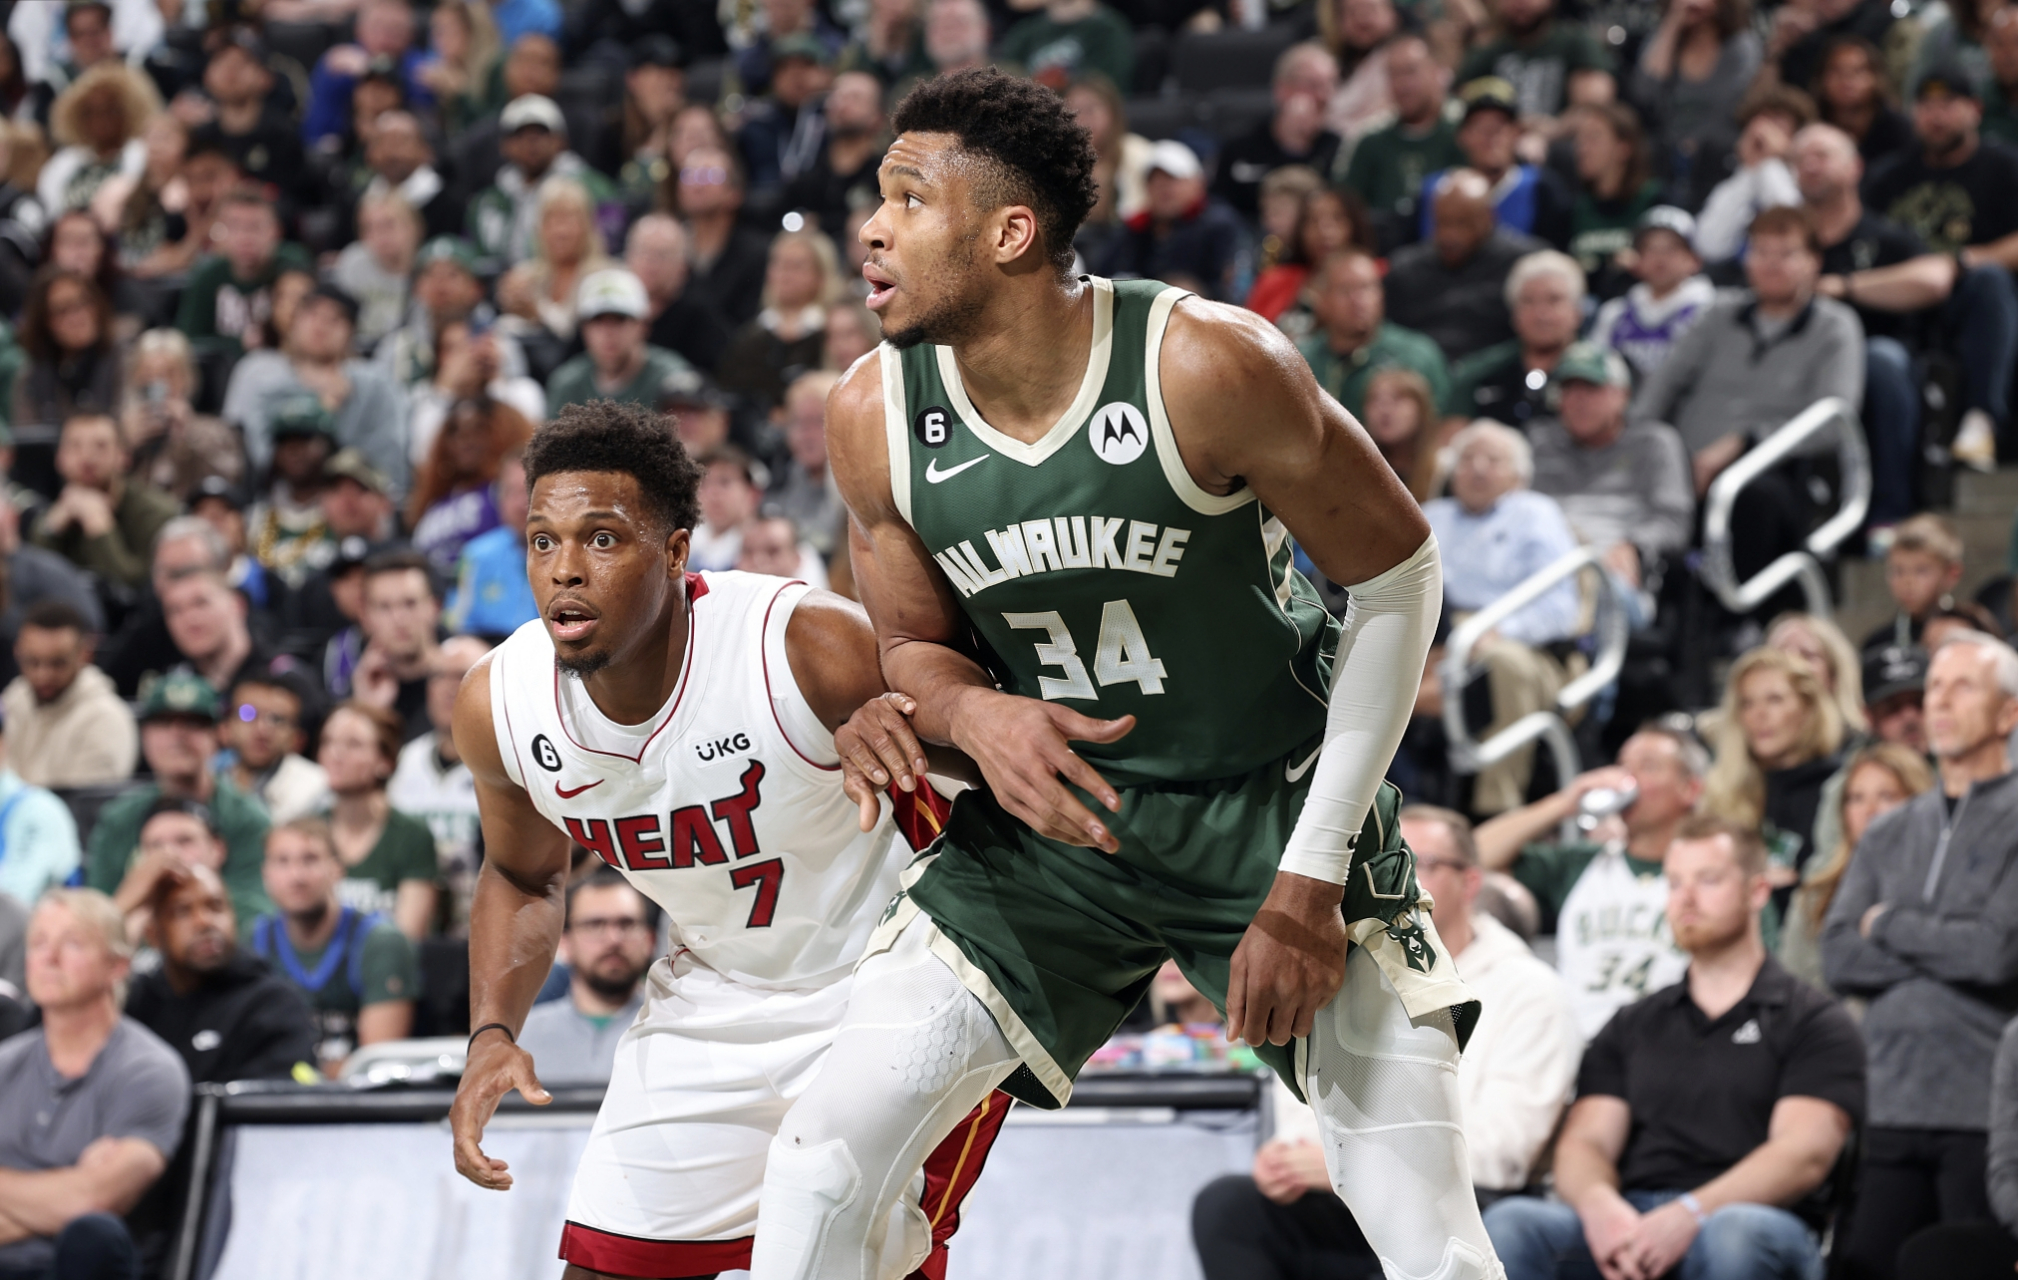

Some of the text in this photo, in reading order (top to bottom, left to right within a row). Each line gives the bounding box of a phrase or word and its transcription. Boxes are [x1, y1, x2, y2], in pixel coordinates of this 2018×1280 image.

[924, 412, 945, 443] 6
[932, 515, 1192, 598] MILWAUKEE
[1001, 599, 1168, 700] 34
[562, 758, 766, 871] HEAT
[729, 857, 785, 929] 7
